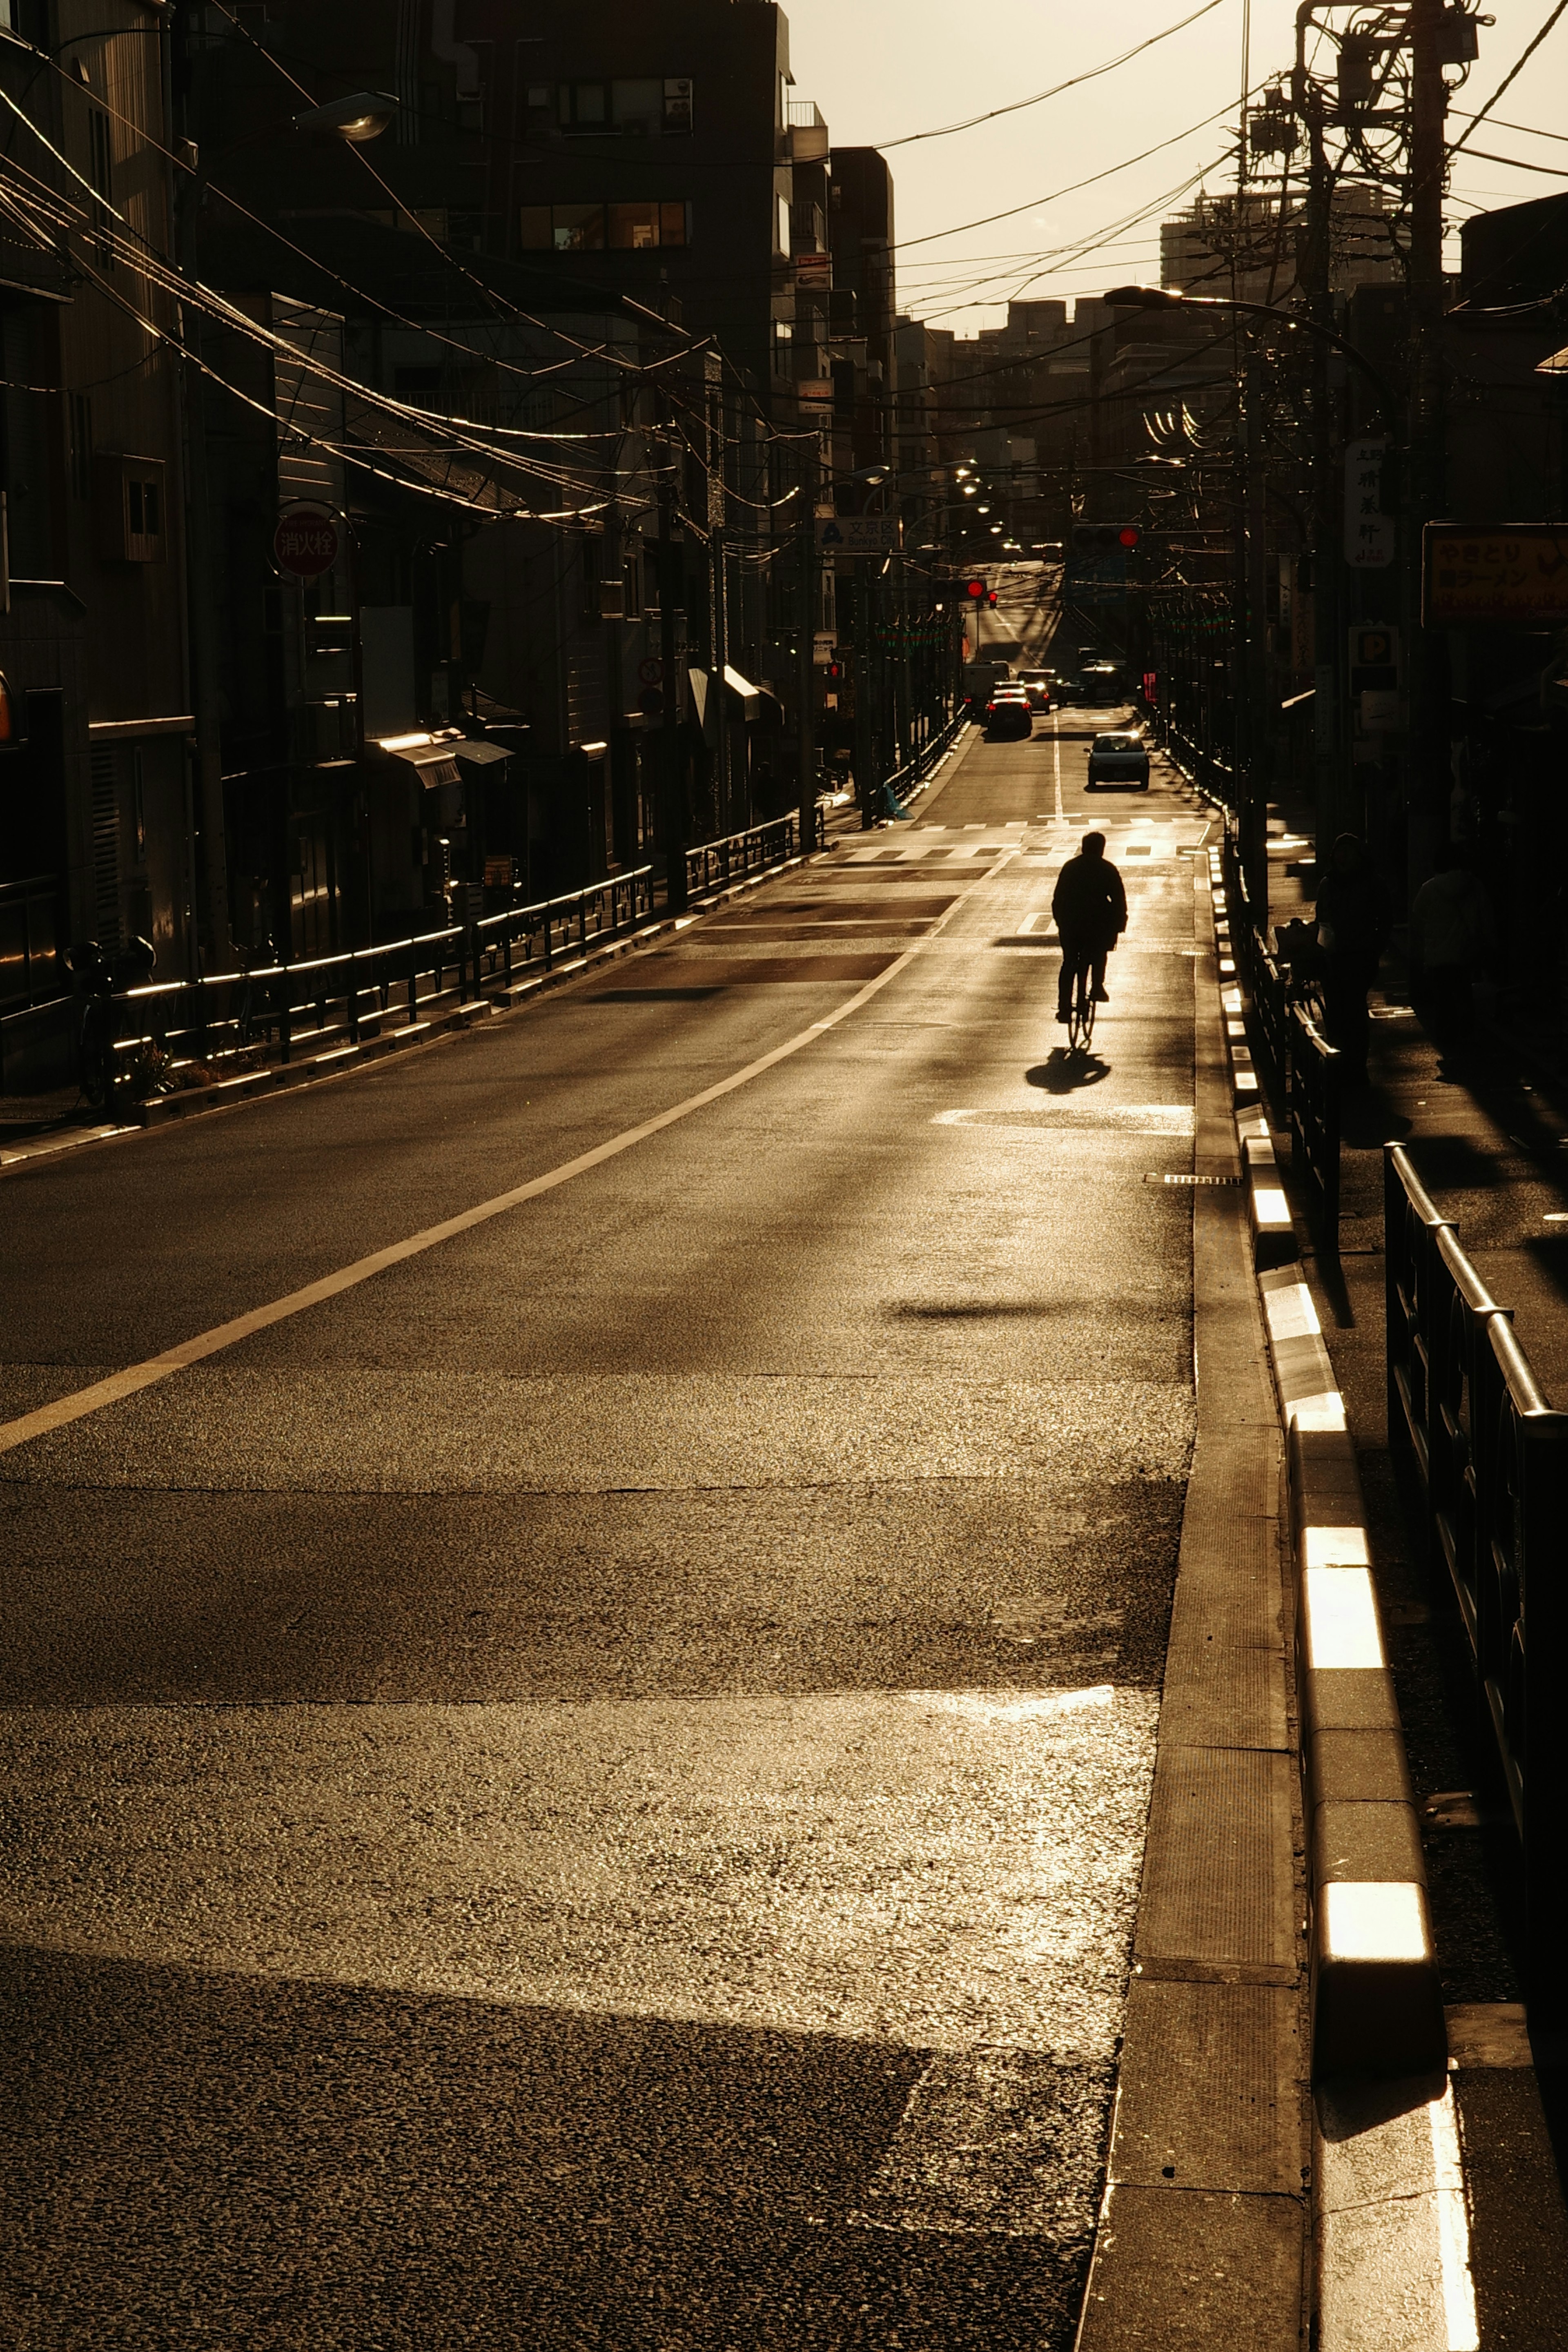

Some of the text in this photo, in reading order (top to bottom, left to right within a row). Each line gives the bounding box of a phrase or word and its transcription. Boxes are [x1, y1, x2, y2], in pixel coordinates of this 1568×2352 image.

[849, 520, 895, 535] 文京区
[281, 531, 333, 556] 消火栓
[849, 535, 896, 548] Bunkyo City
[1439, 543, 1520, 564] やきとり
[1363, 635, 1386, 660] P
